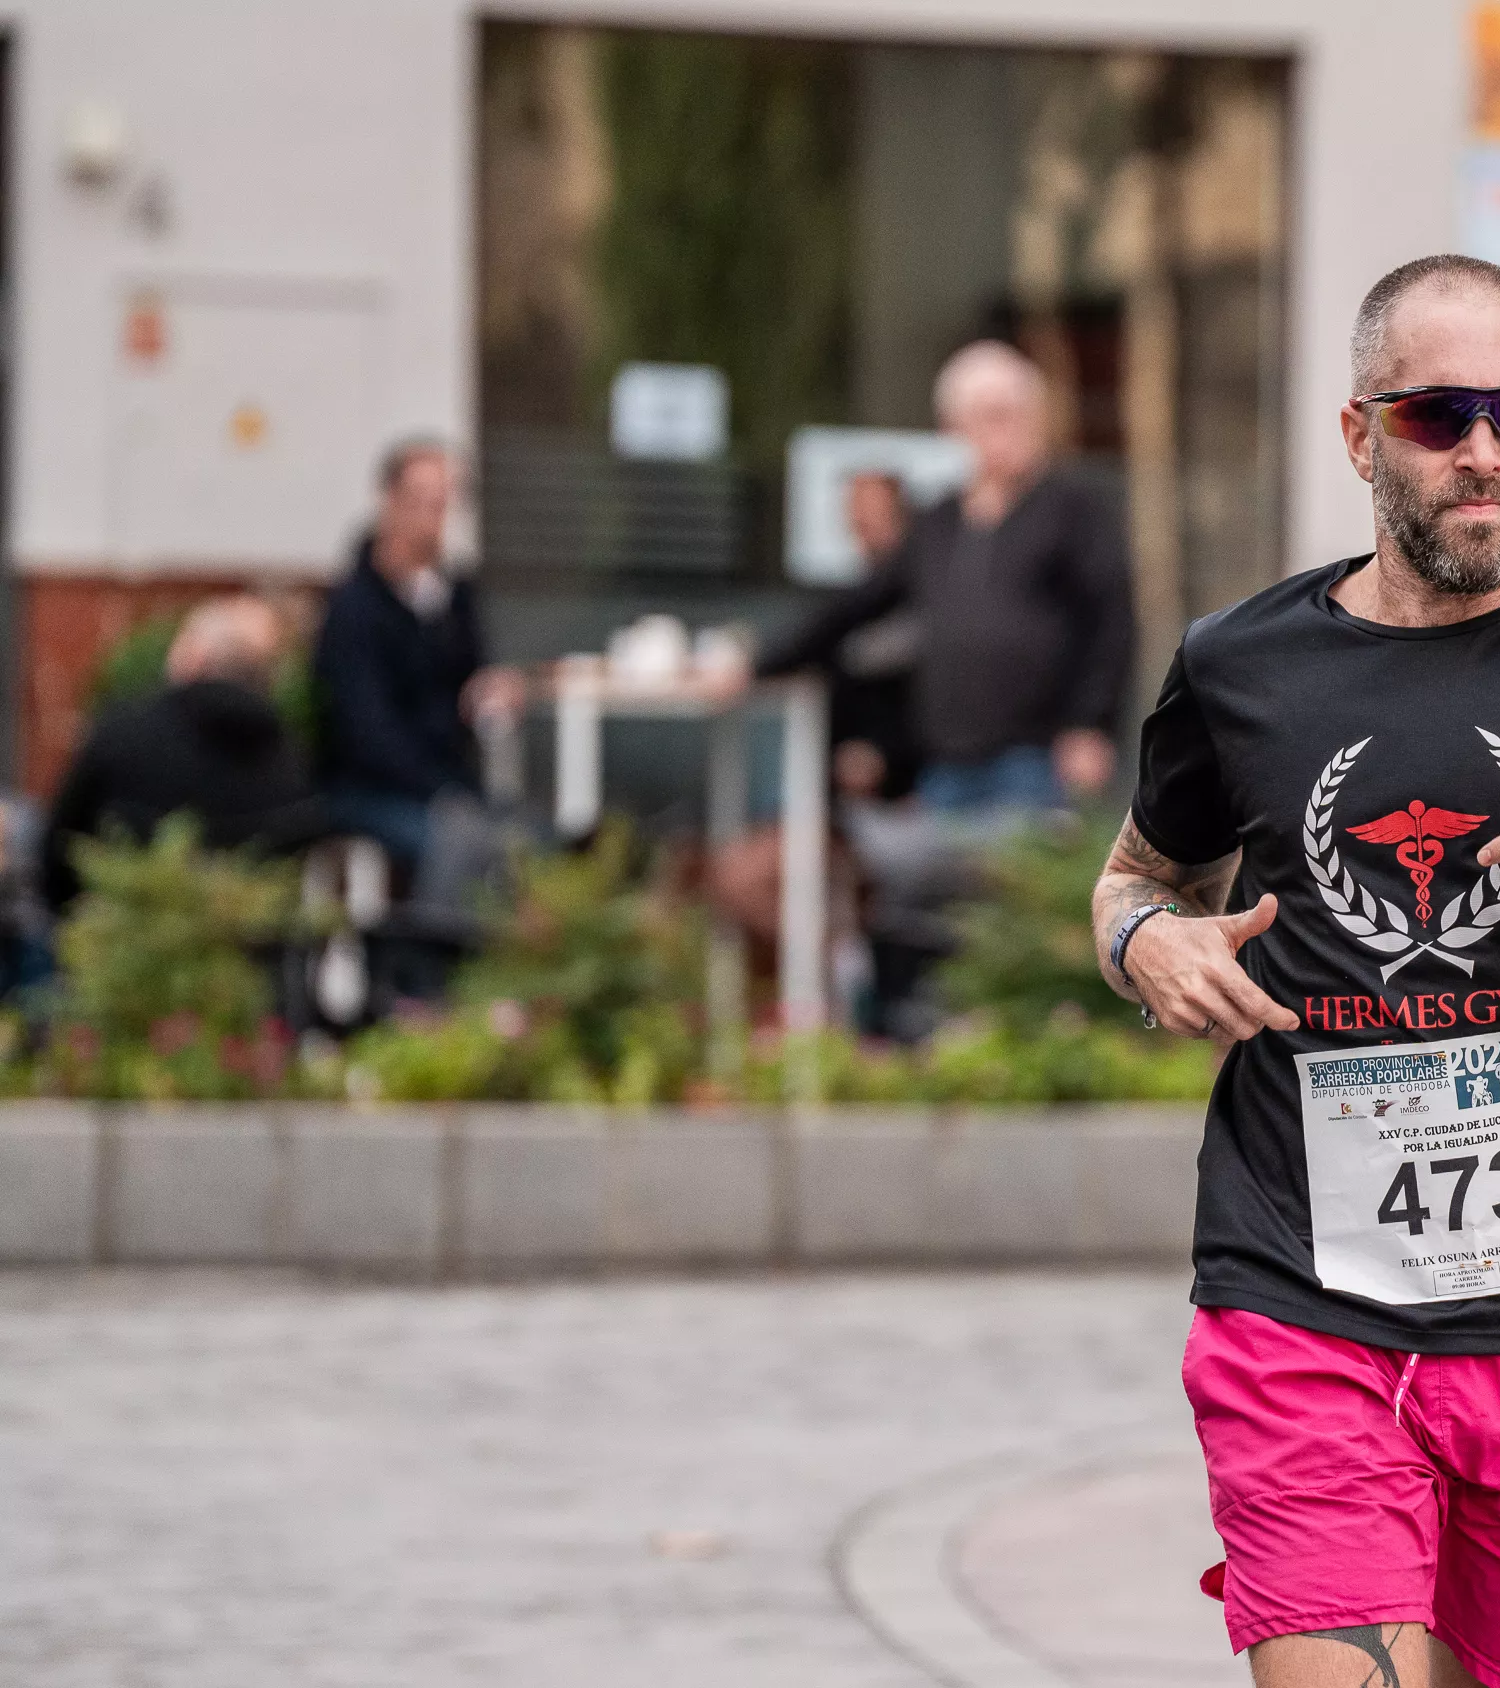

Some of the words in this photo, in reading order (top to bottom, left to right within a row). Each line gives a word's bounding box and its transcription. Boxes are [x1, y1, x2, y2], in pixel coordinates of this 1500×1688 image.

[1304, 992, 1457, 1031] HERMES
[1308, 1060, 1359, 1076] CIRCUITO
[1363, 1054, 1429, 1071] PROVINCIAL
[1432, 1053, 1447, 1066] DE
[1310, 1070, 1373, 1087] CARRERAS
[1377, 1065, 1448, 1083] POPULARES
[1312, 1085, 1373, 1099] DIPUTACIÓN
[1379, 1085, 1392, 1095] DE
[1399, 1079, 1451, 1093] CÓRDOBA
[1400, 1105, 1430, 1114] IMDECO
[1379, 1128, 1401, 1140] XXV
[1403, 1128, 1422, 1138] C.P.
[1425, 1123, 1464, 1136] CIUDAD
[1467, 1120, 1481, 1131] DE
[1403, 1143, 1424, 1153] POR
[1427, 1141, 1442, 1151] LA
[1444, 1132, 1498, 1149] IGUALDAD
[1401, 1256, 1436, 1268] FELIX
[1438, 1251, 1477, 1264] OSUNA
[1457, 1266, 1494, 1276] APROXIMADA
[1466, 1280, 1486, 1288] HORAS
